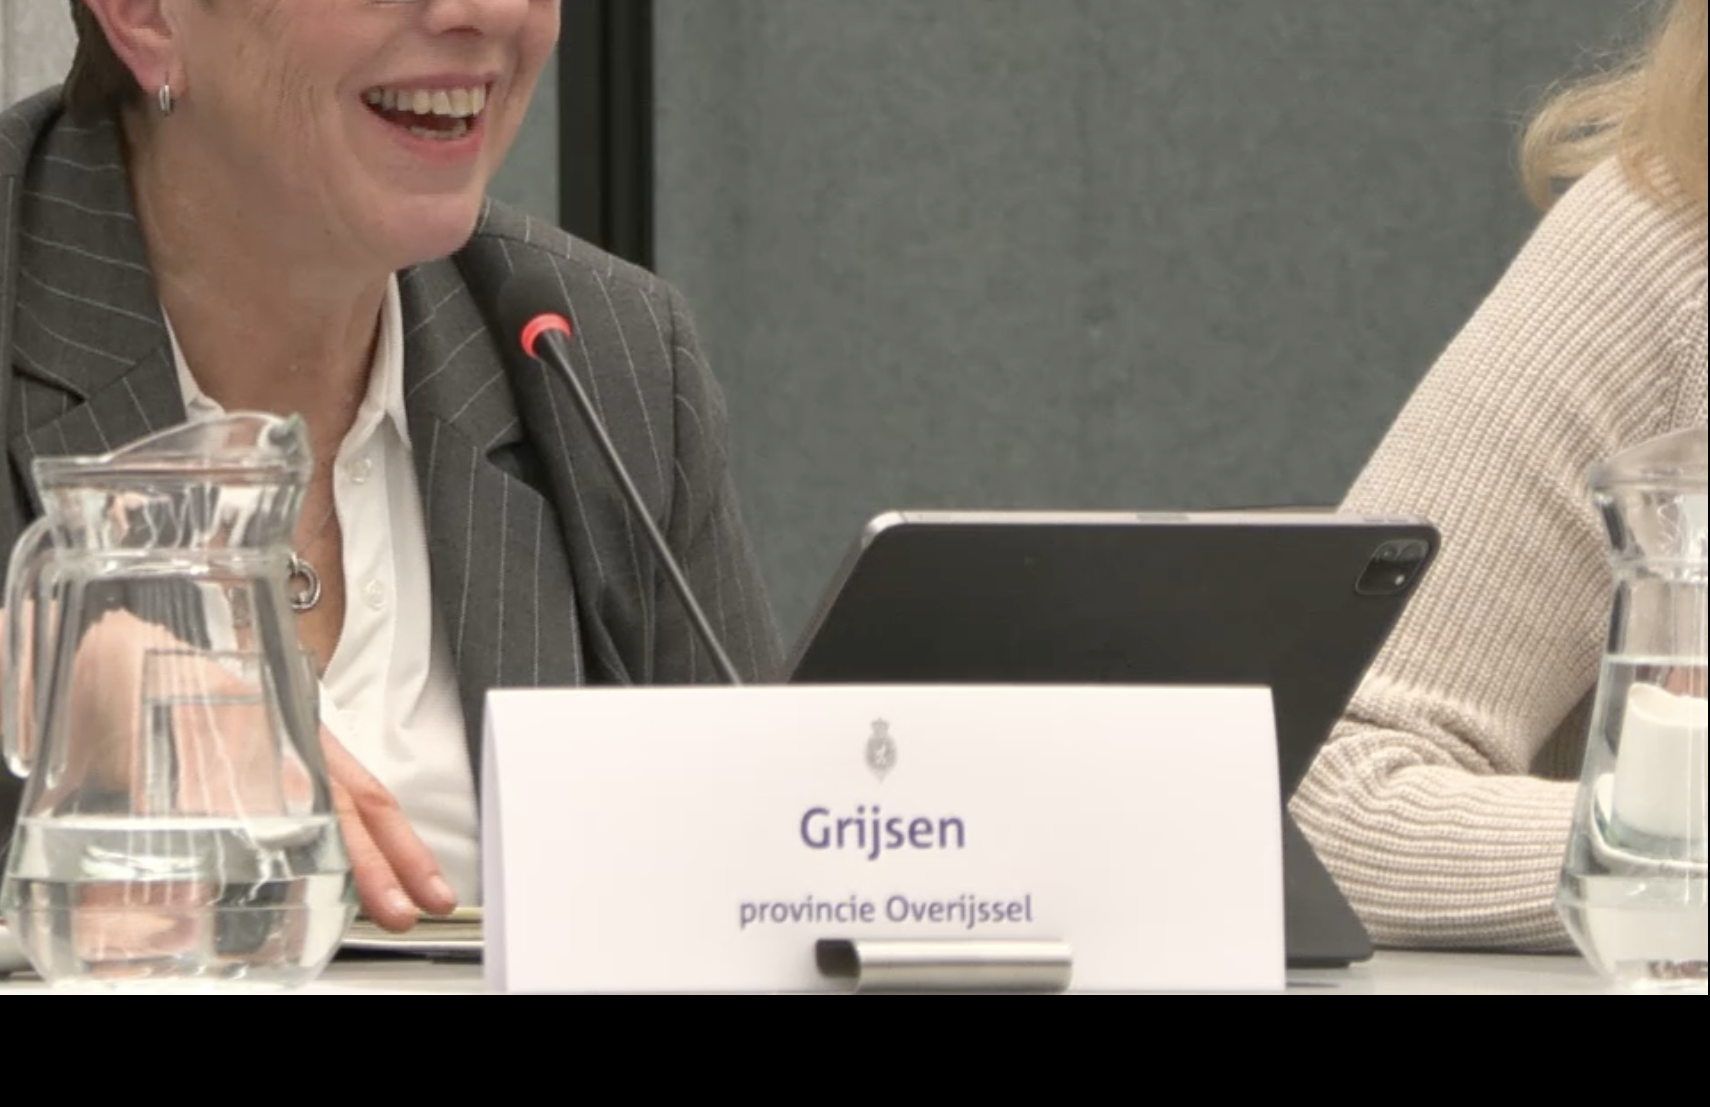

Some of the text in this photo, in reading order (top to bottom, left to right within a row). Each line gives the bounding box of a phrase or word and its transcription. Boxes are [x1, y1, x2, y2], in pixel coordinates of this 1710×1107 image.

[798, 804, 966, 861] Grijsen
[739, 893, 1033, 930] provincie Overijssel
